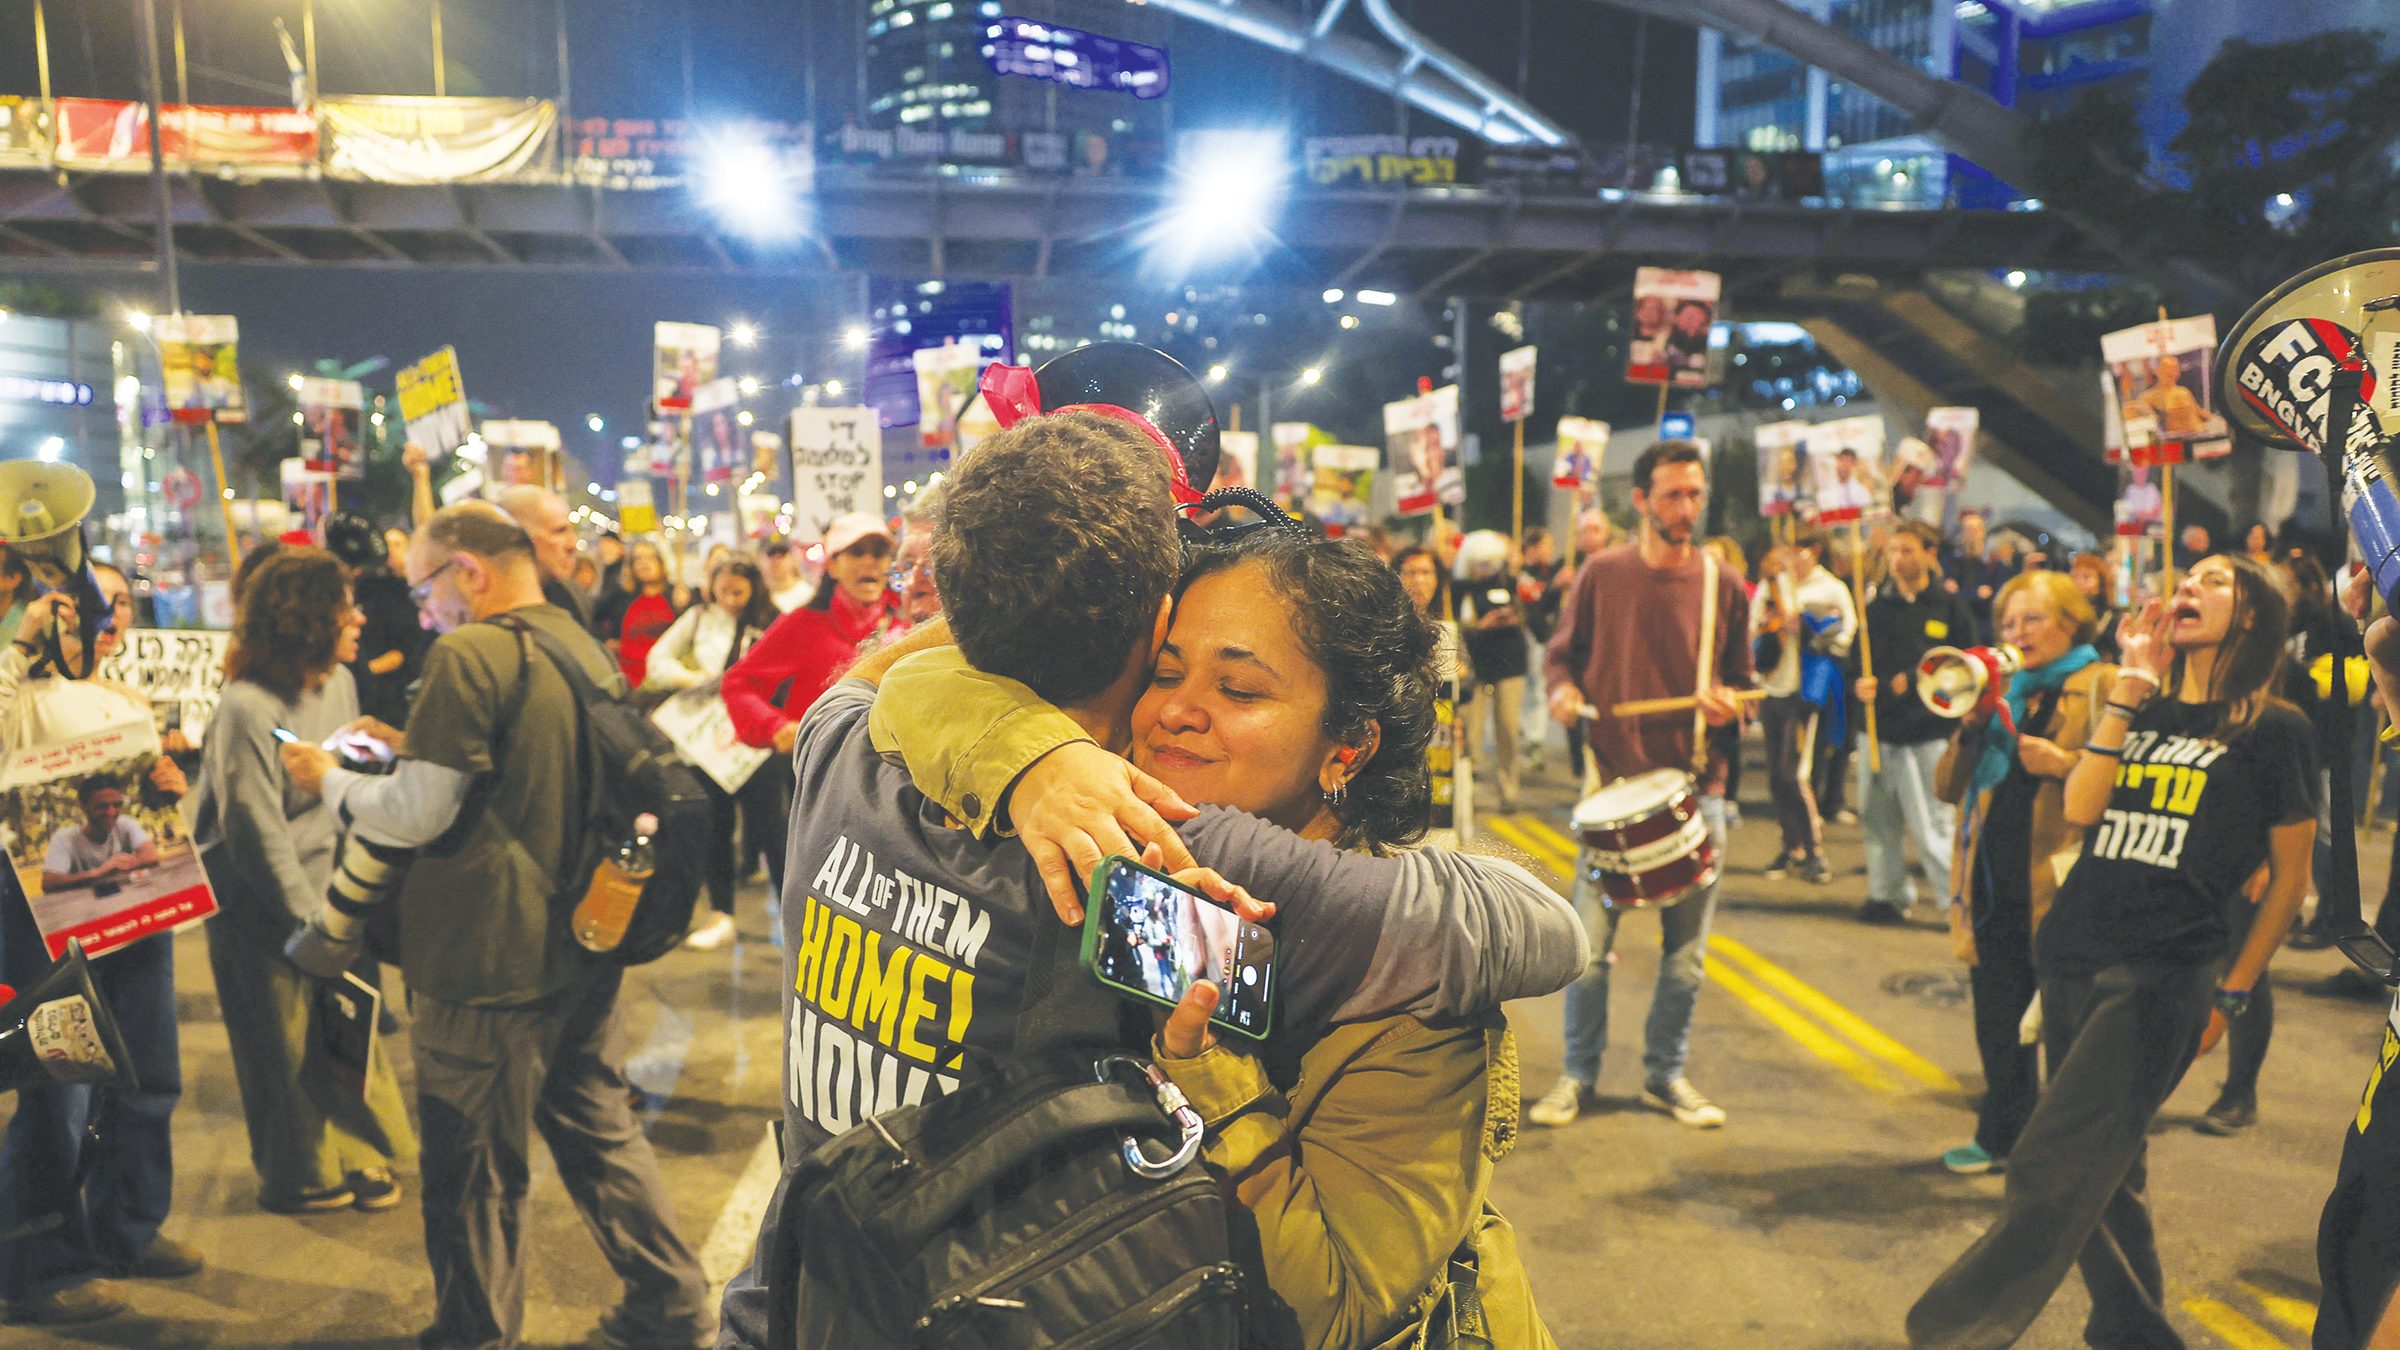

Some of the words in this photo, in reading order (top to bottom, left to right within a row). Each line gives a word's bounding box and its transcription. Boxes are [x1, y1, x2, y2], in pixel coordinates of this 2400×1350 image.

[815, 472, 865, 490] STOP
[2148, 734, 2229, 769] למה
[2093, 809, 2190, 869] בעזה
[811, 835, 874, 917] ALL
[871, 873, 897, 910] OF
[890, 868, 991, 968] THEM
[794, 895, 976, 1071] HOME!
